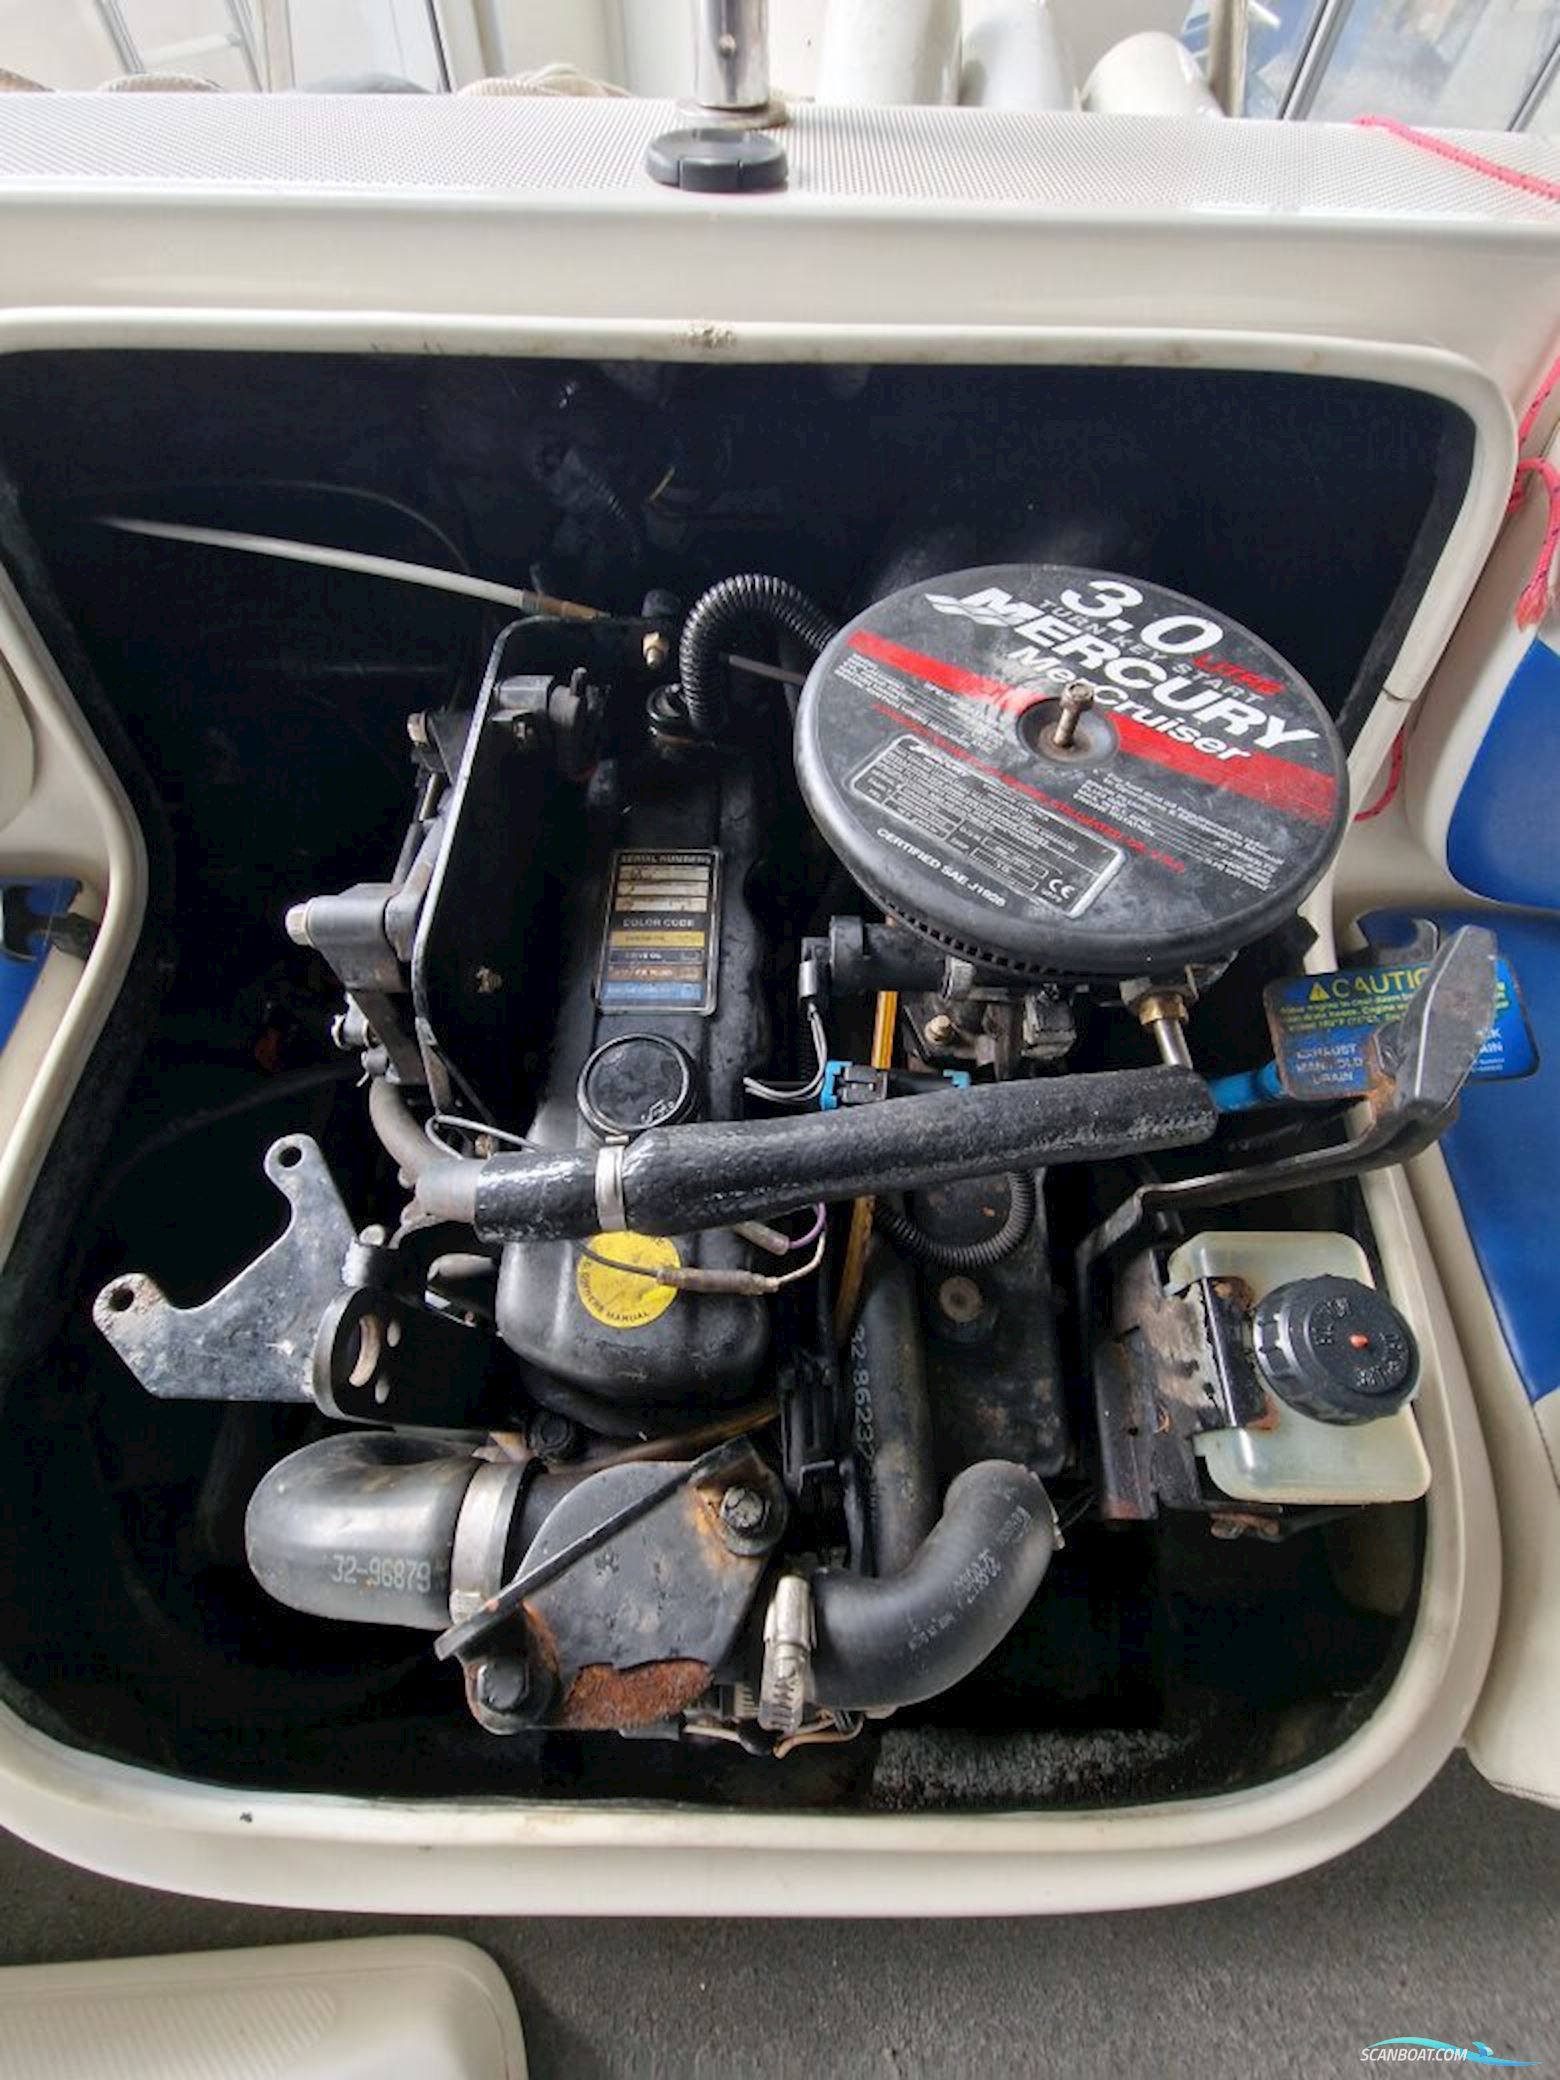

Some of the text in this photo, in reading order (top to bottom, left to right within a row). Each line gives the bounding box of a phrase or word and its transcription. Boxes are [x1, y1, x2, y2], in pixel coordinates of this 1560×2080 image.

[1061, 580, 1223, 654] 3.0
[946, 587, 1320, 749] MERCURY
[1038, 599, 1265, 705] TURN KEY START
[877, 827, 942, 869] CERTIFIED
[623, 918, 695, 927] COLOR CODE
[330, 1553, 432, 1594] 32-96879
